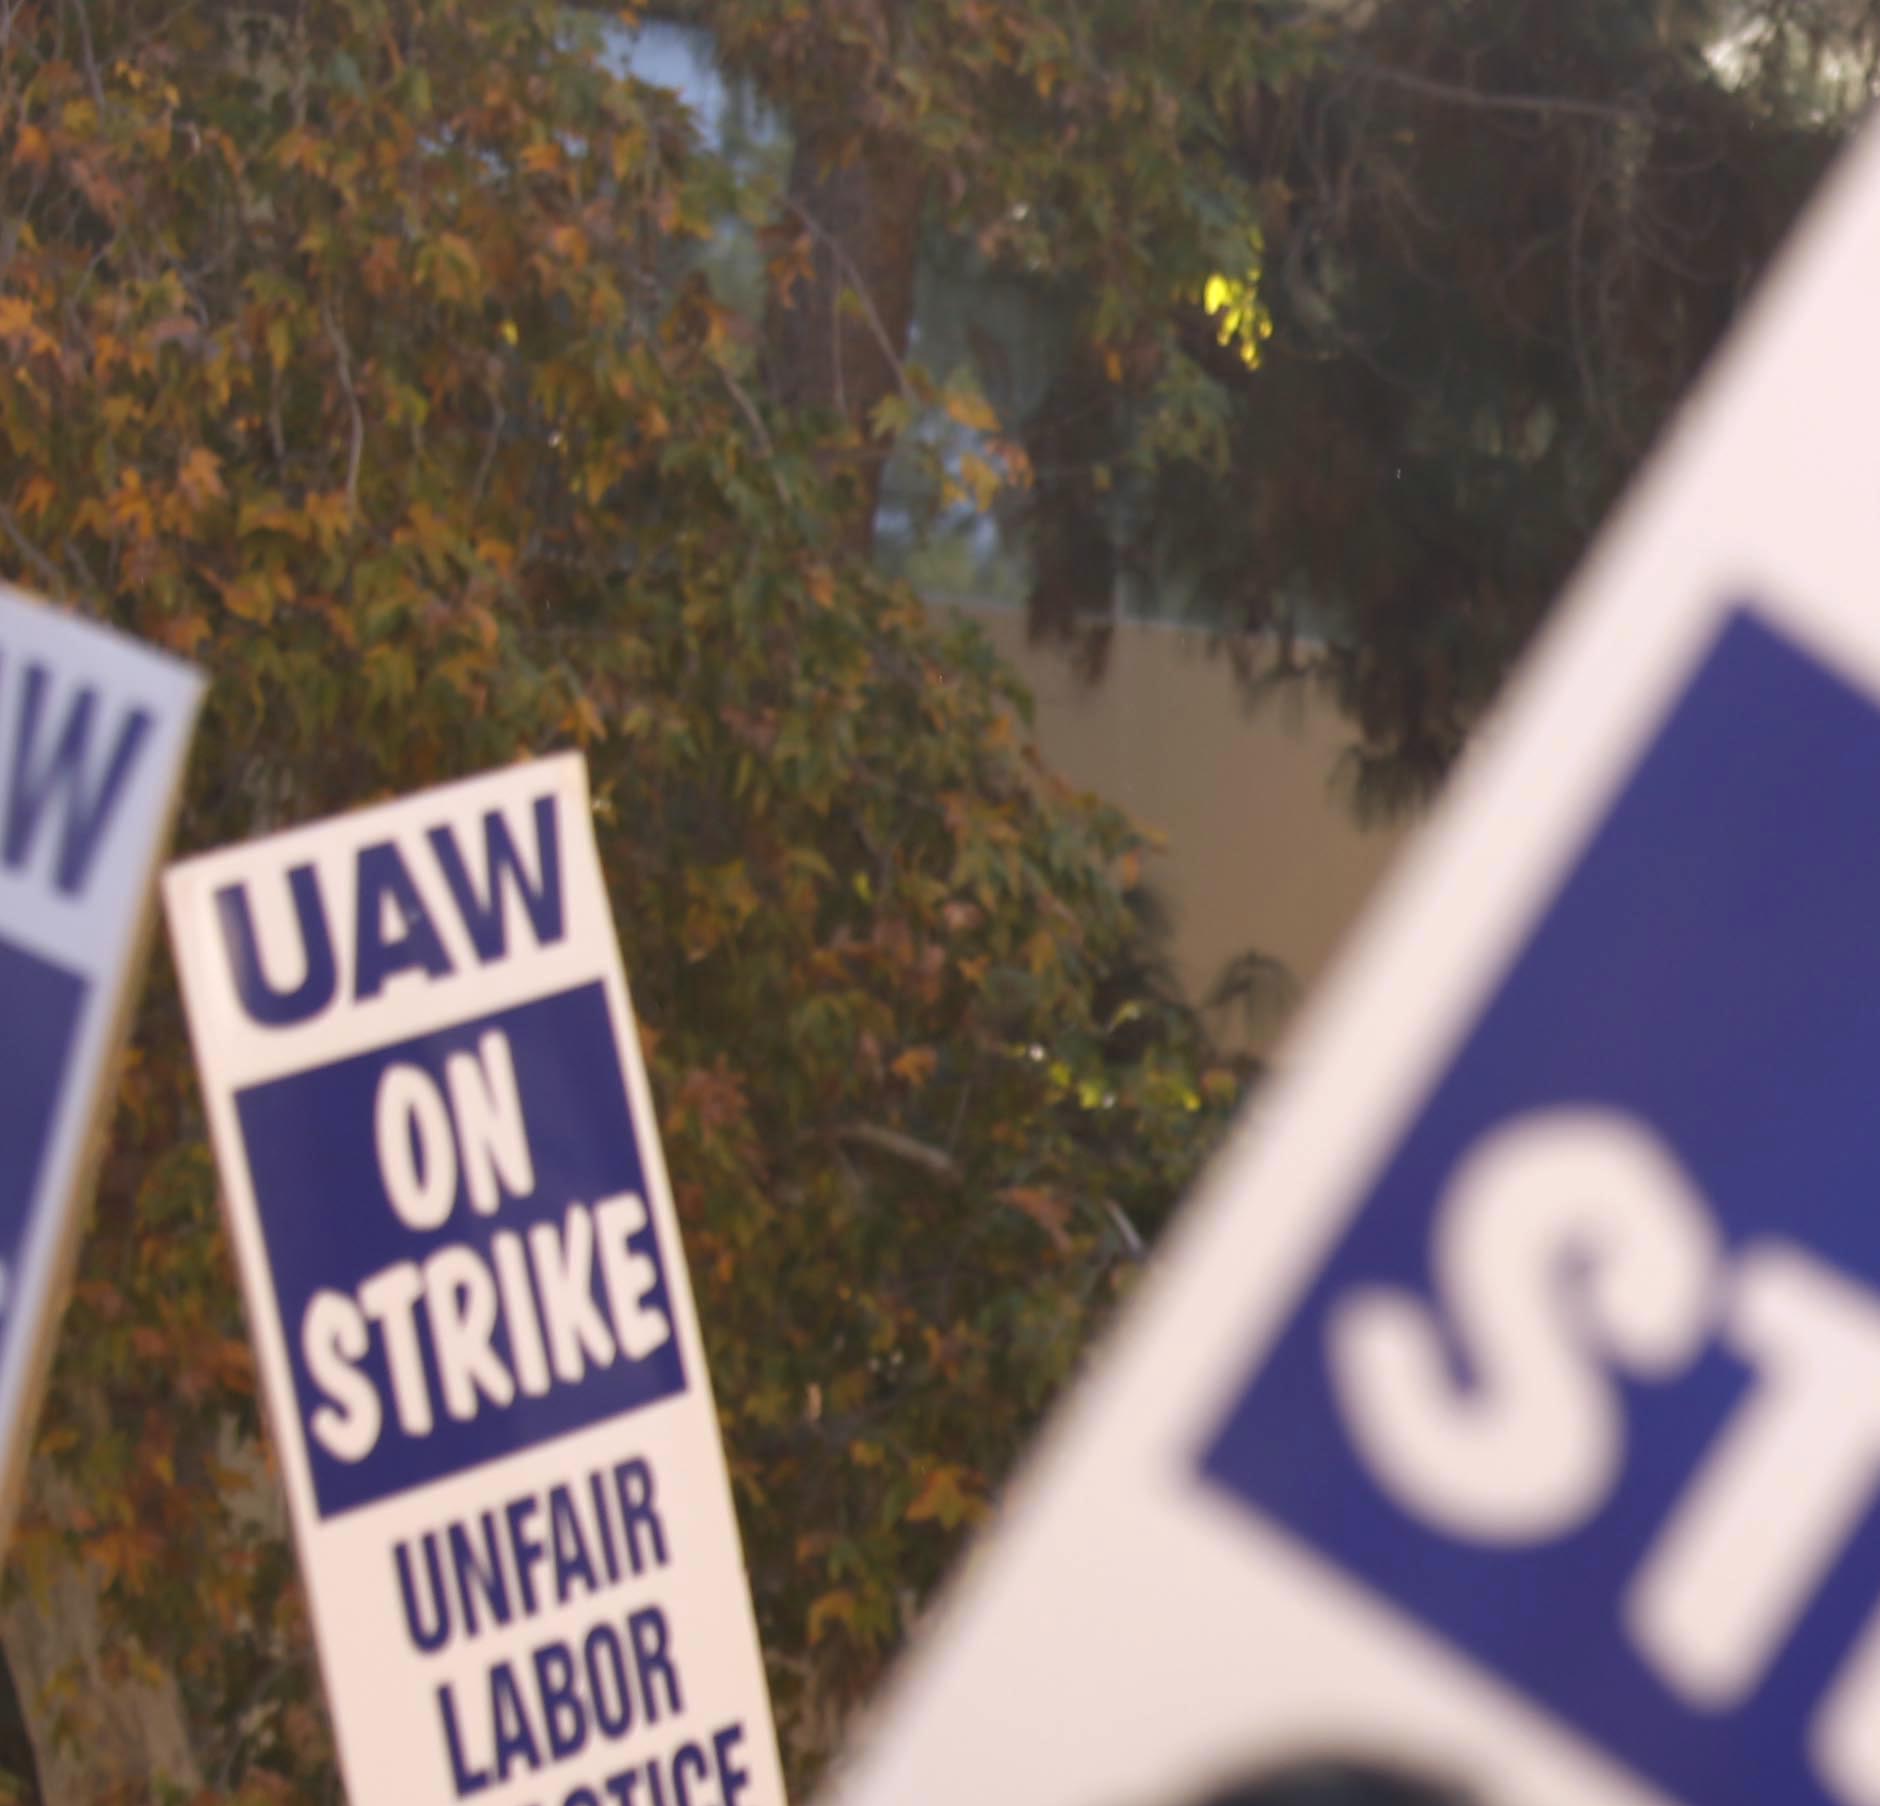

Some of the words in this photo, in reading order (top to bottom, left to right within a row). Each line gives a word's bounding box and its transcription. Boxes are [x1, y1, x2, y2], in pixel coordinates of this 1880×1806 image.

[212, 796, 567, 1030] UAW
[375, 1030, 533, 1232] ON
[302, 1192, 670, 1462] STRIKE
[392, 1455, 671, 1656] UNFAIR
[435, 1603, 684, 1800] LABOR
